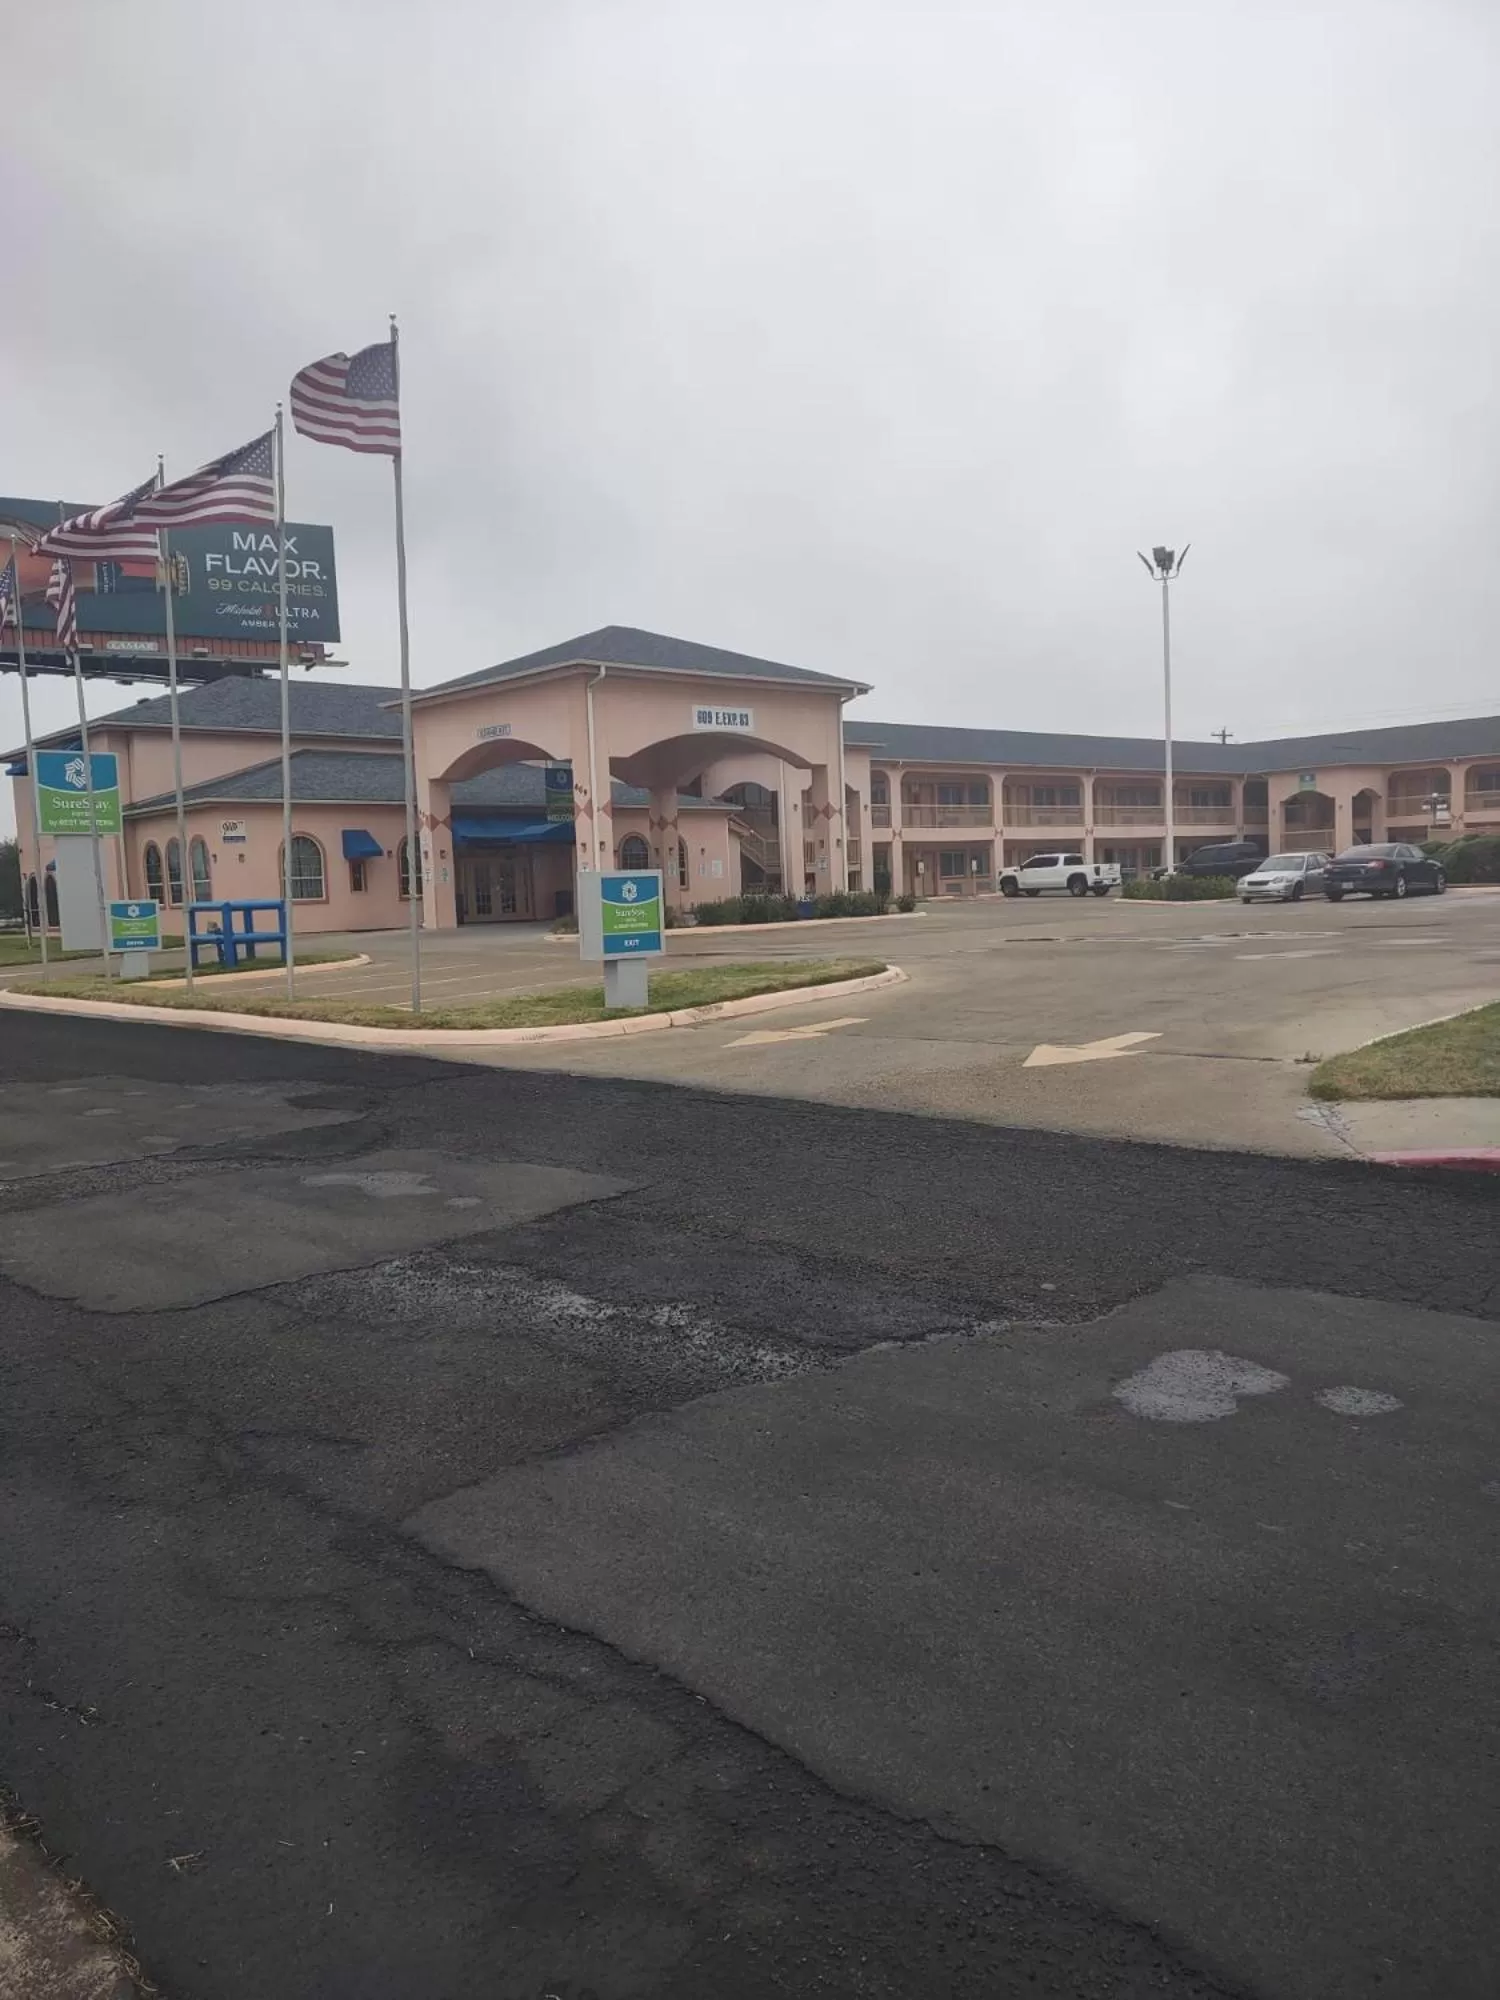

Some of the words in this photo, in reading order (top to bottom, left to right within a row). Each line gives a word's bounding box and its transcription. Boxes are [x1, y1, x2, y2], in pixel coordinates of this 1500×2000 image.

[232, 531, 298, 554] MAX
[205, 553, 328, 580] FLAVOR.
[207, 578, 232, 591] 99
